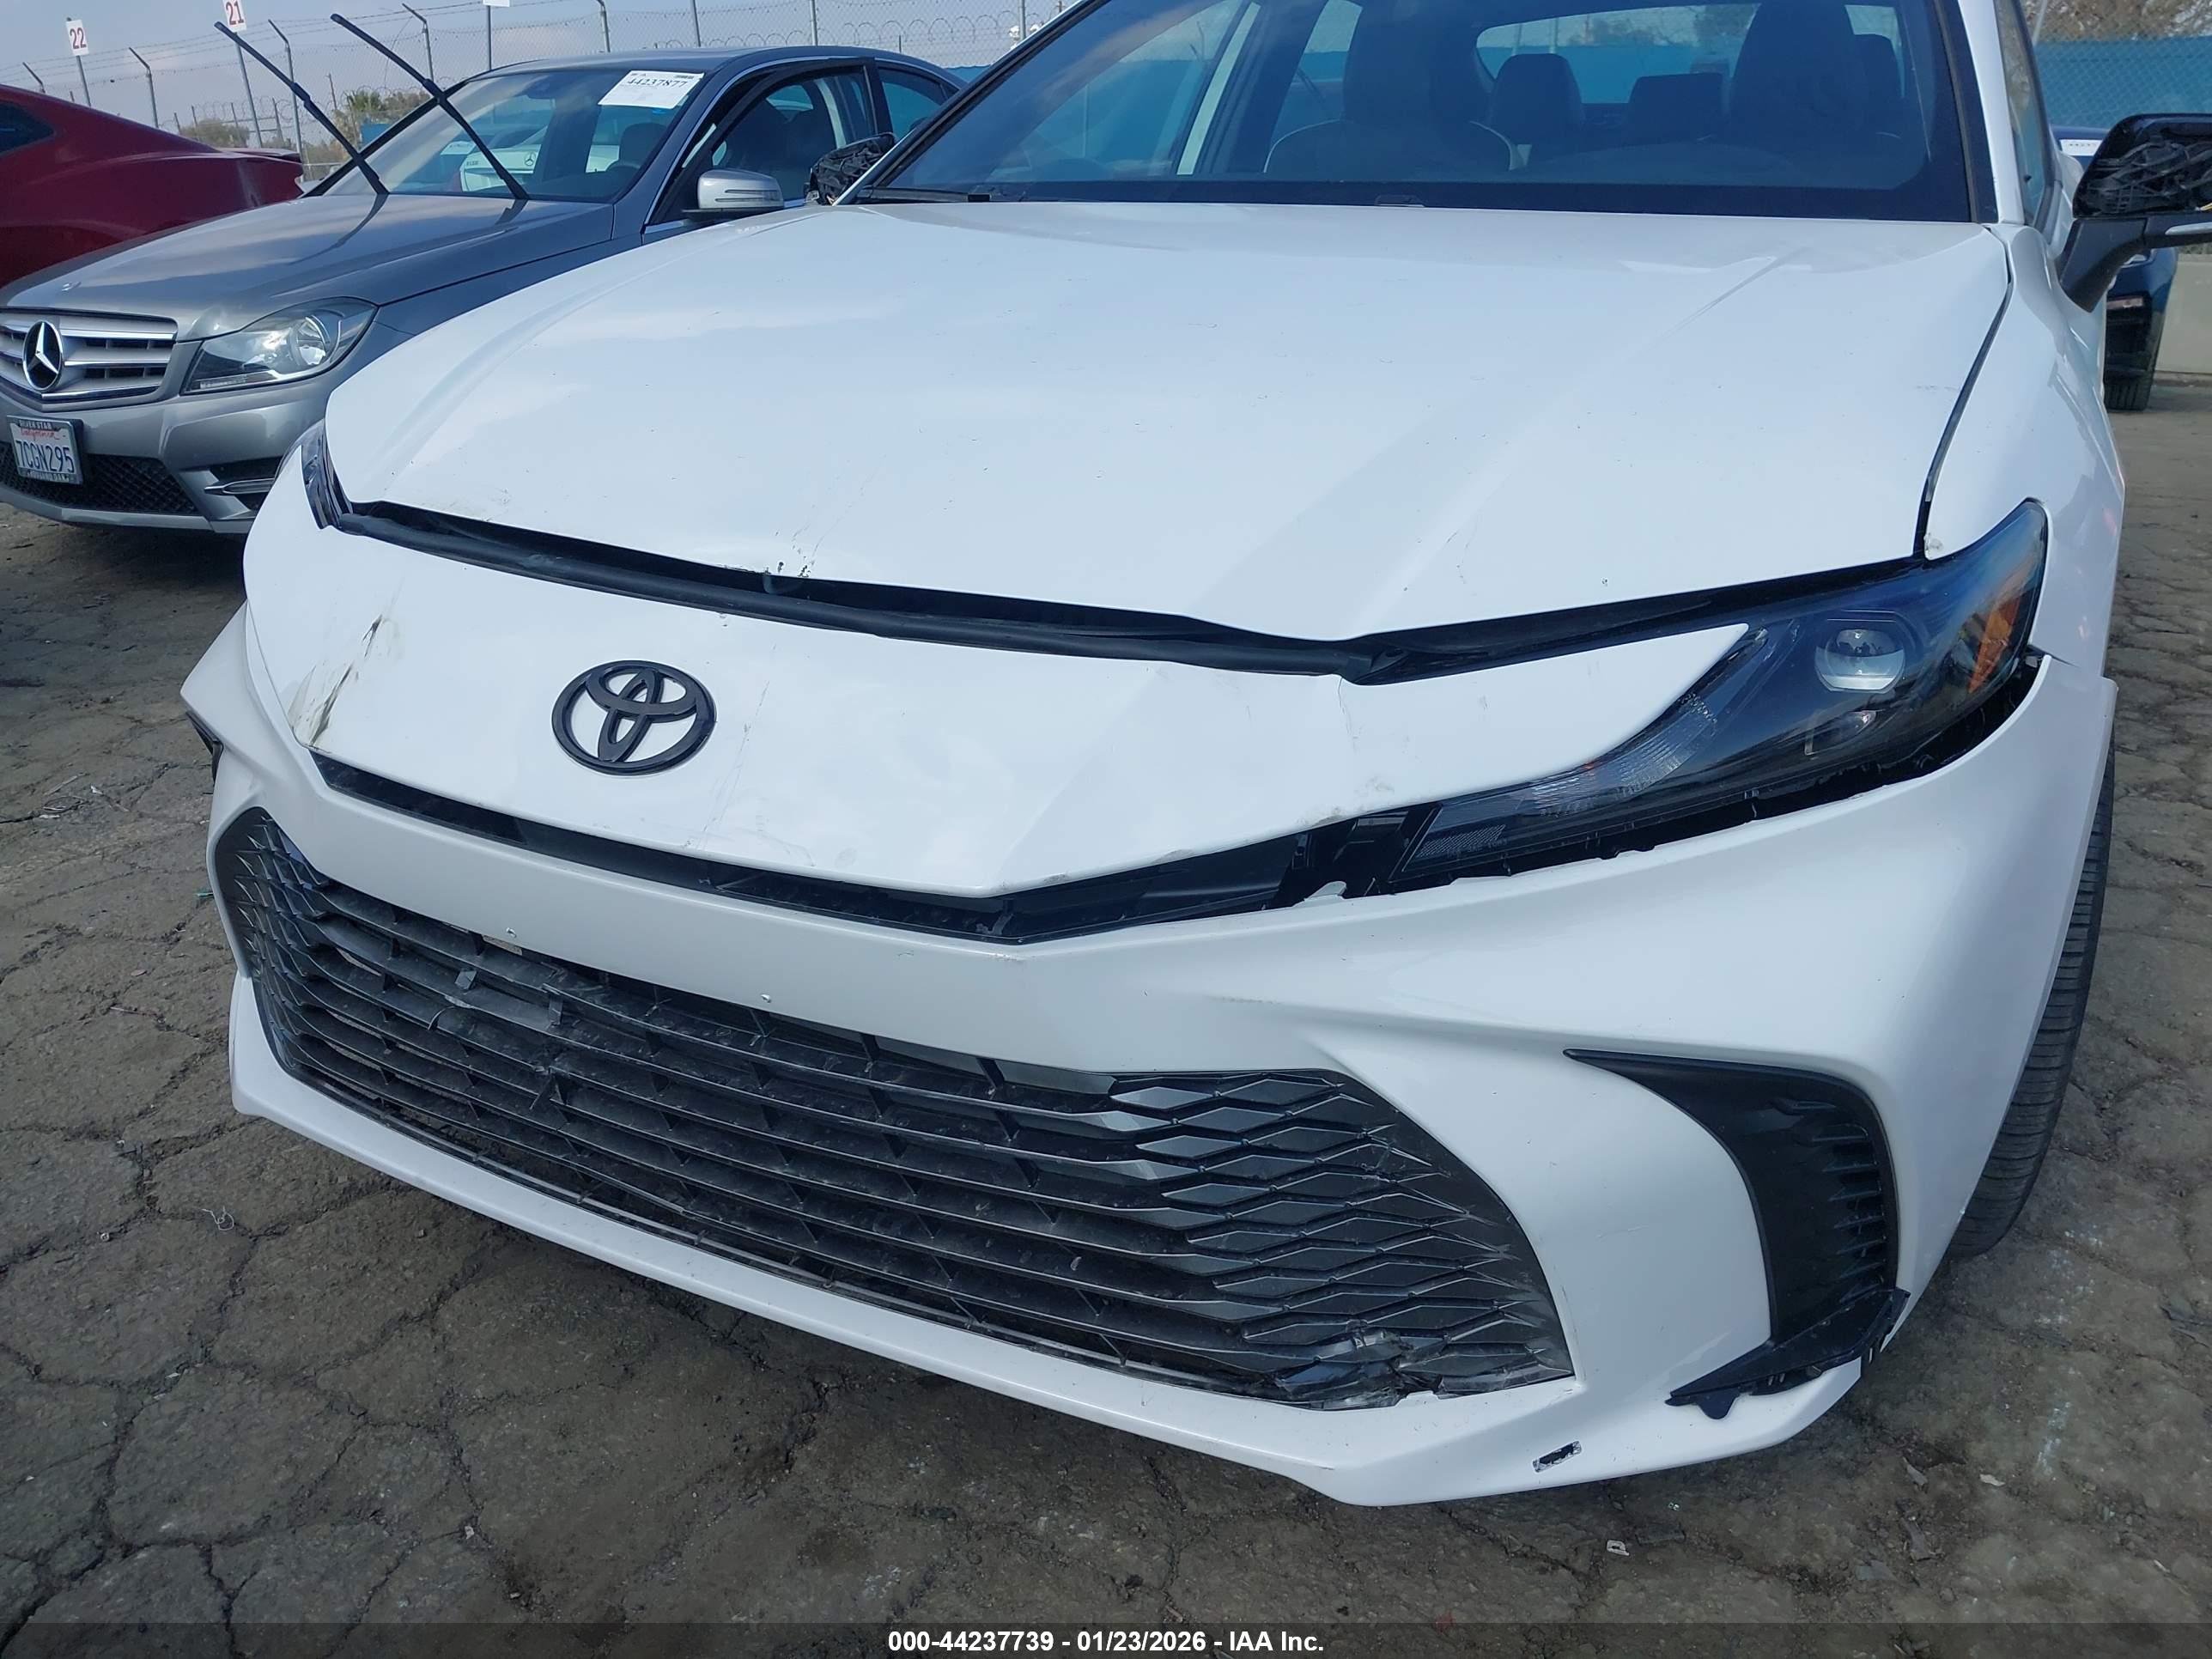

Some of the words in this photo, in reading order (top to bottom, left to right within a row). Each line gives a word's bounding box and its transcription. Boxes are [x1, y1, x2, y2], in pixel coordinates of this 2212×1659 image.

[226, 1, 245, 26] 21
[69, 27, 87, 50] 22
[15, 439, 76, 474] 7CGN295
